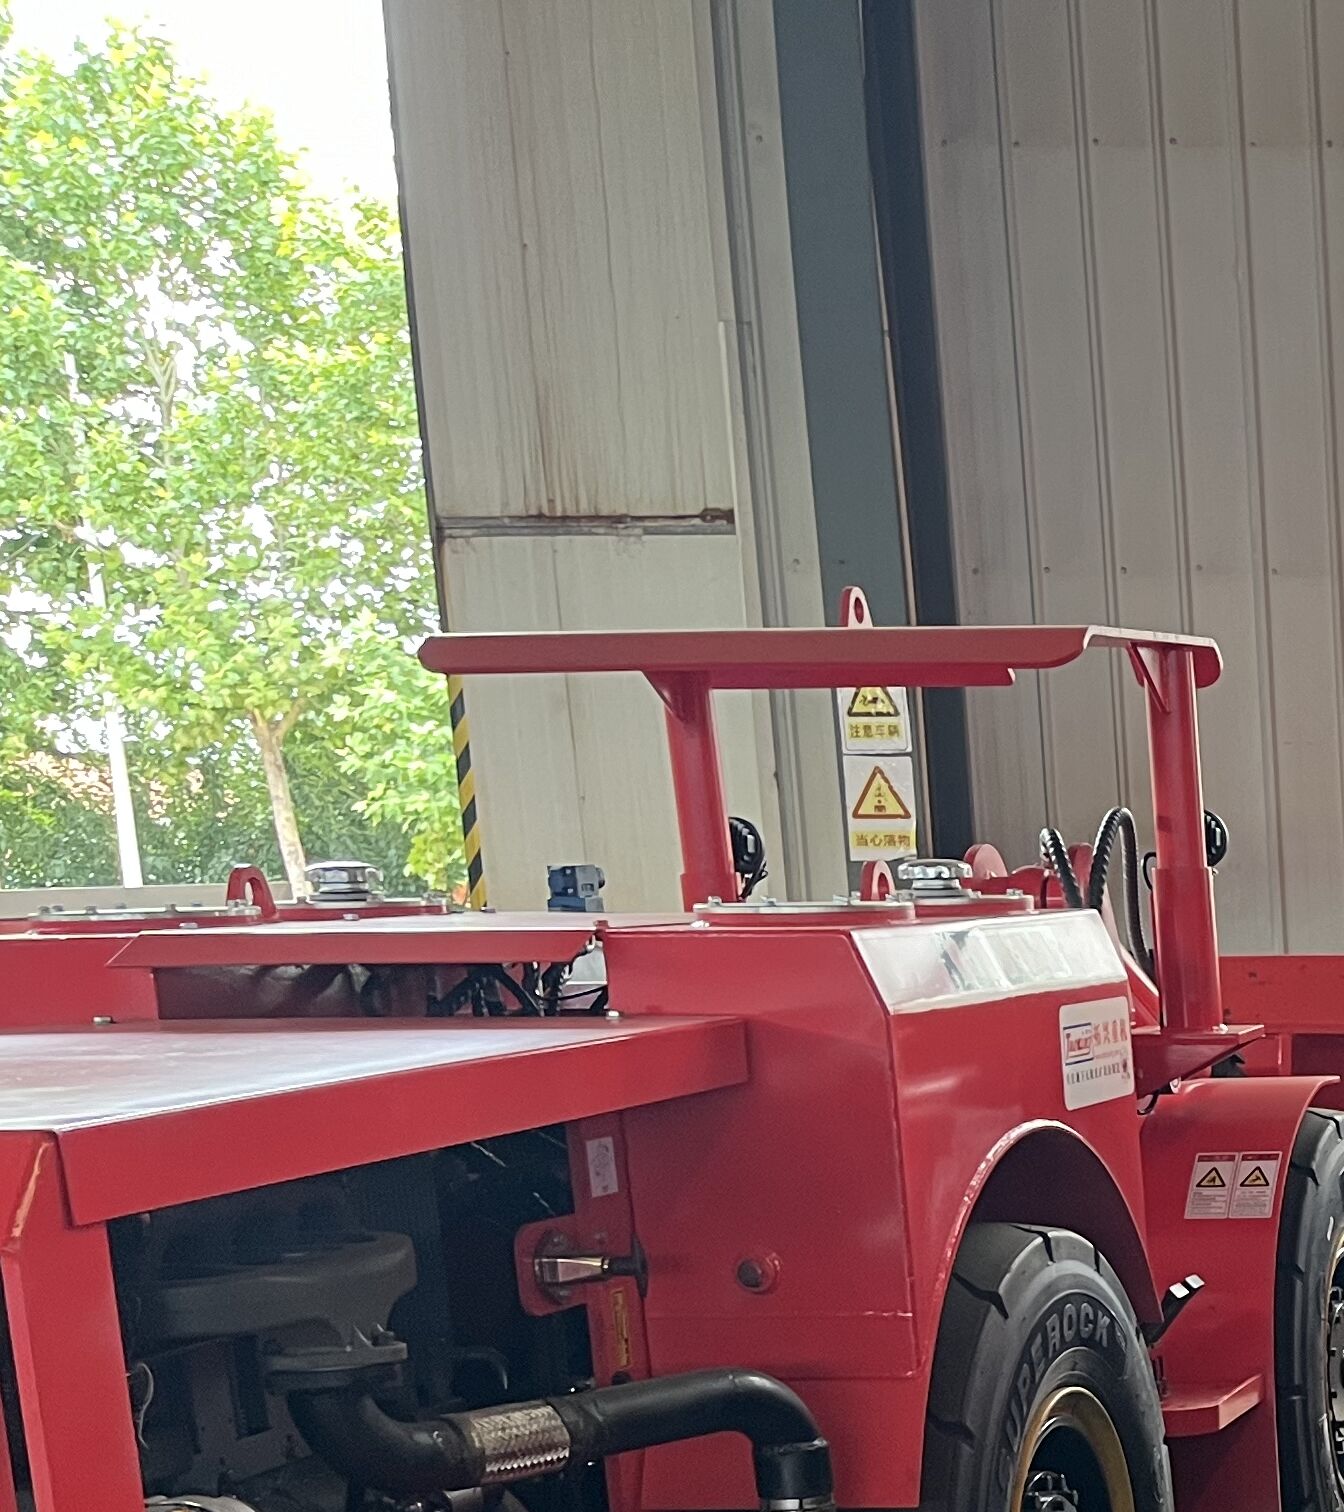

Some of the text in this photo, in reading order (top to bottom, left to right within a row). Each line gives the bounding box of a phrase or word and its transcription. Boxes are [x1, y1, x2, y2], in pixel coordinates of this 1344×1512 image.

[850, 724, 901, 738] 注意车辆
[855, 833, 910, 848] 当心落物
